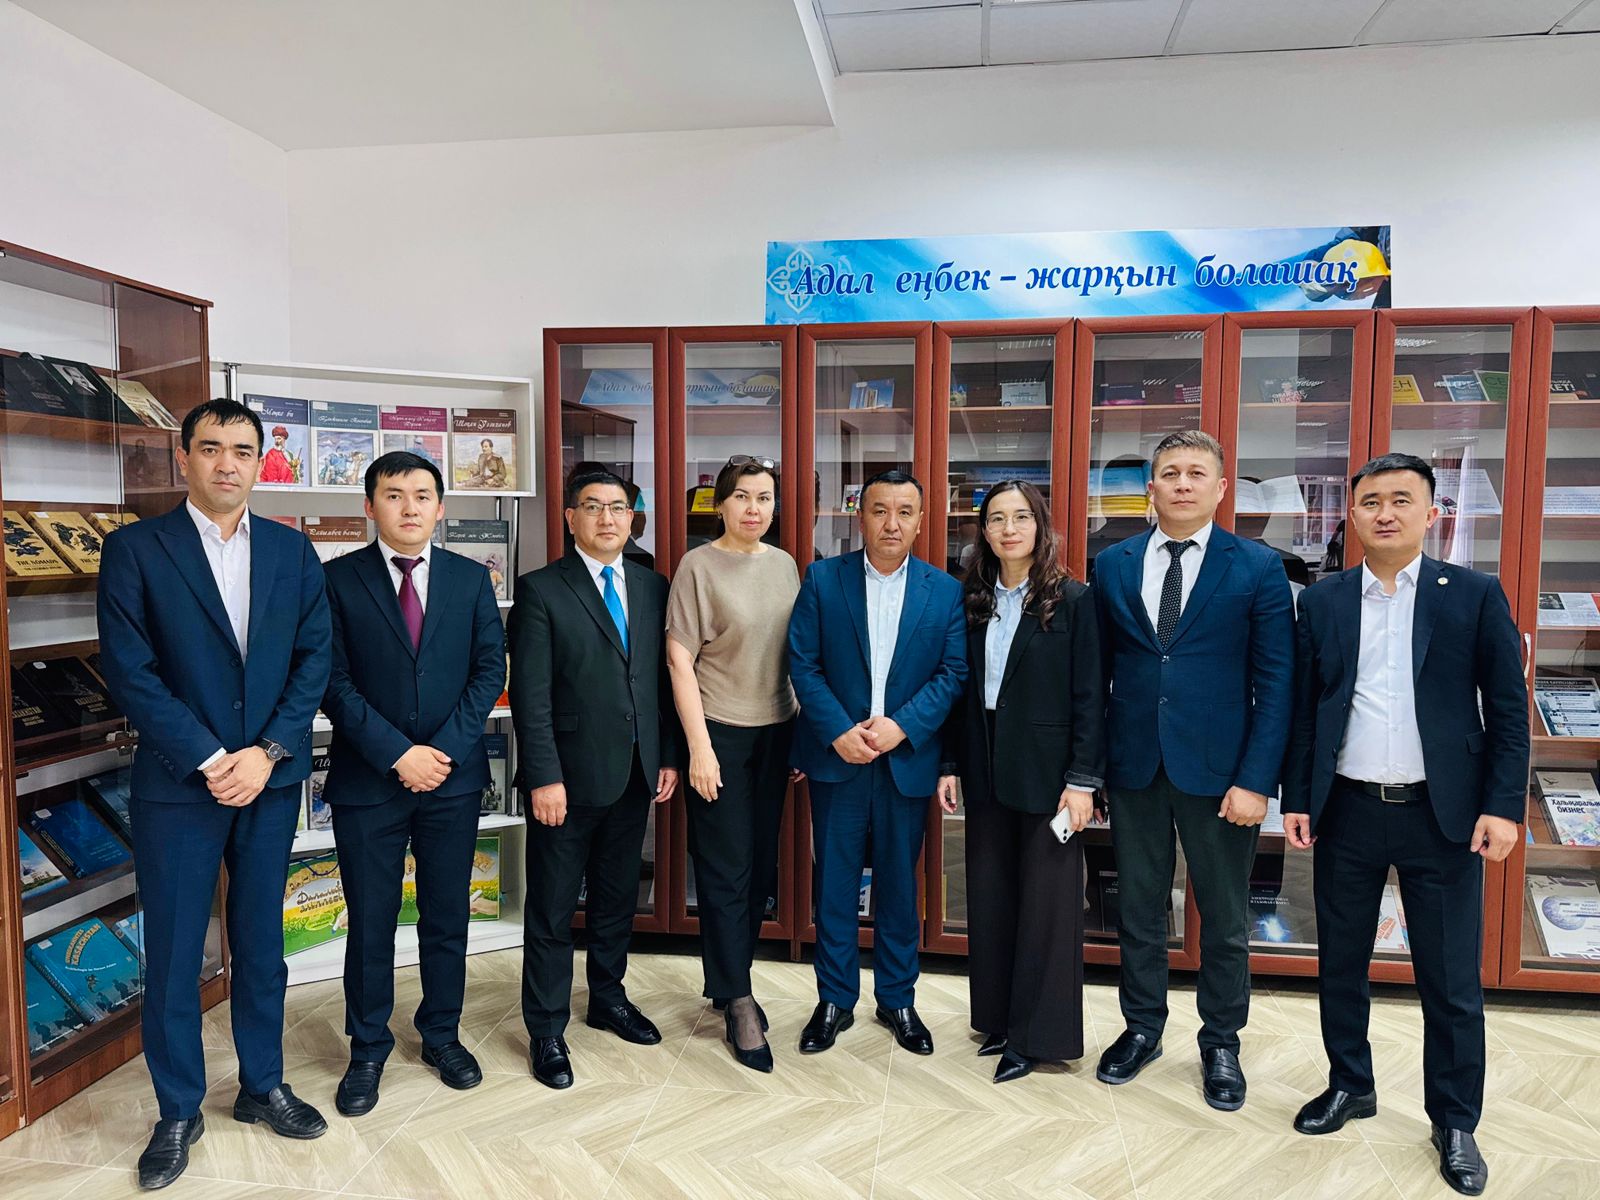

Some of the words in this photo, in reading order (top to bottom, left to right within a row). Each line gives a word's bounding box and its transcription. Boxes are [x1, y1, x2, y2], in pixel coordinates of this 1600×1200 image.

[792, 263, 874, 295] Адал
[896, 260, 991, 301] еңбек
[1025, 264, 1178, 297] жарқын
[1193, 252, 1358, 293] болашақ
[1557, 806, 1586, 815] бизнес
